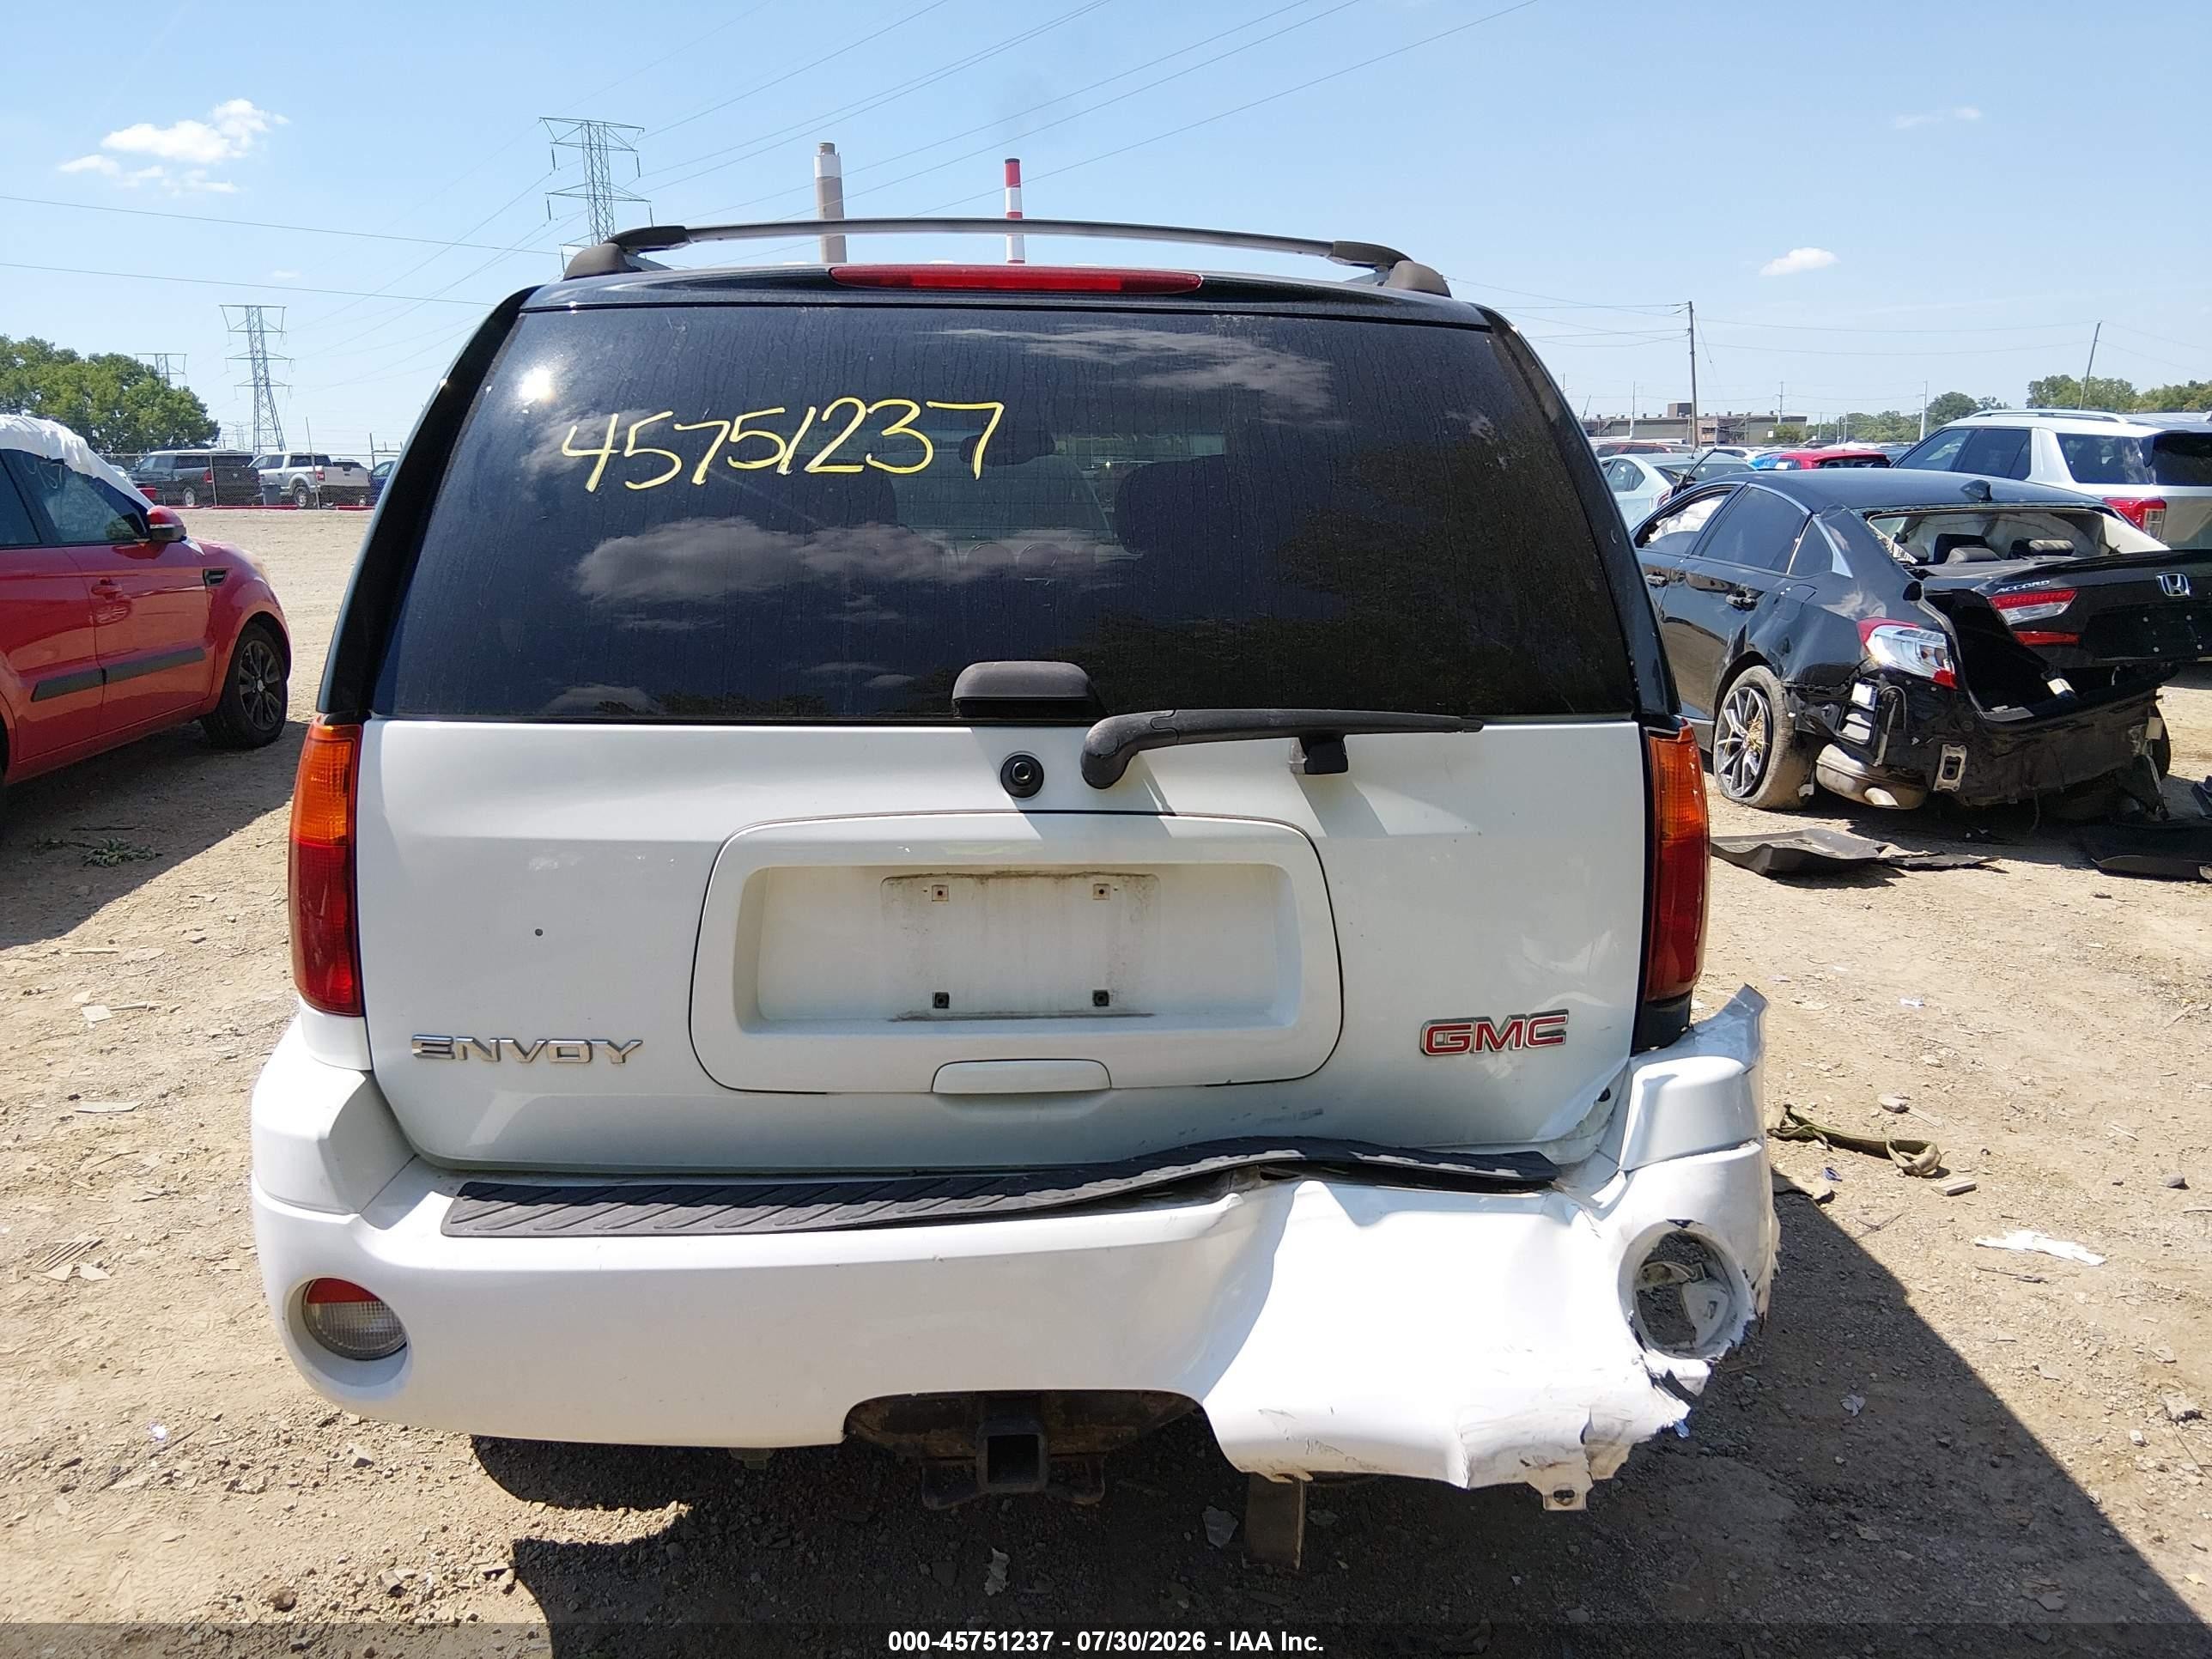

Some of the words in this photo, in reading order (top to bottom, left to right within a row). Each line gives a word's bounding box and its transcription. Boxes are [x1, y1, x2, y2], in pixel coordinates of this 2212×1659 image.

[562, 397, 1005, 493] 45751237
[1994, 580, 2051, 594] ACCORD
[411, 1034, 643, 1064] ENVOY
[1419, 1008, 1569, 1056] GMC
